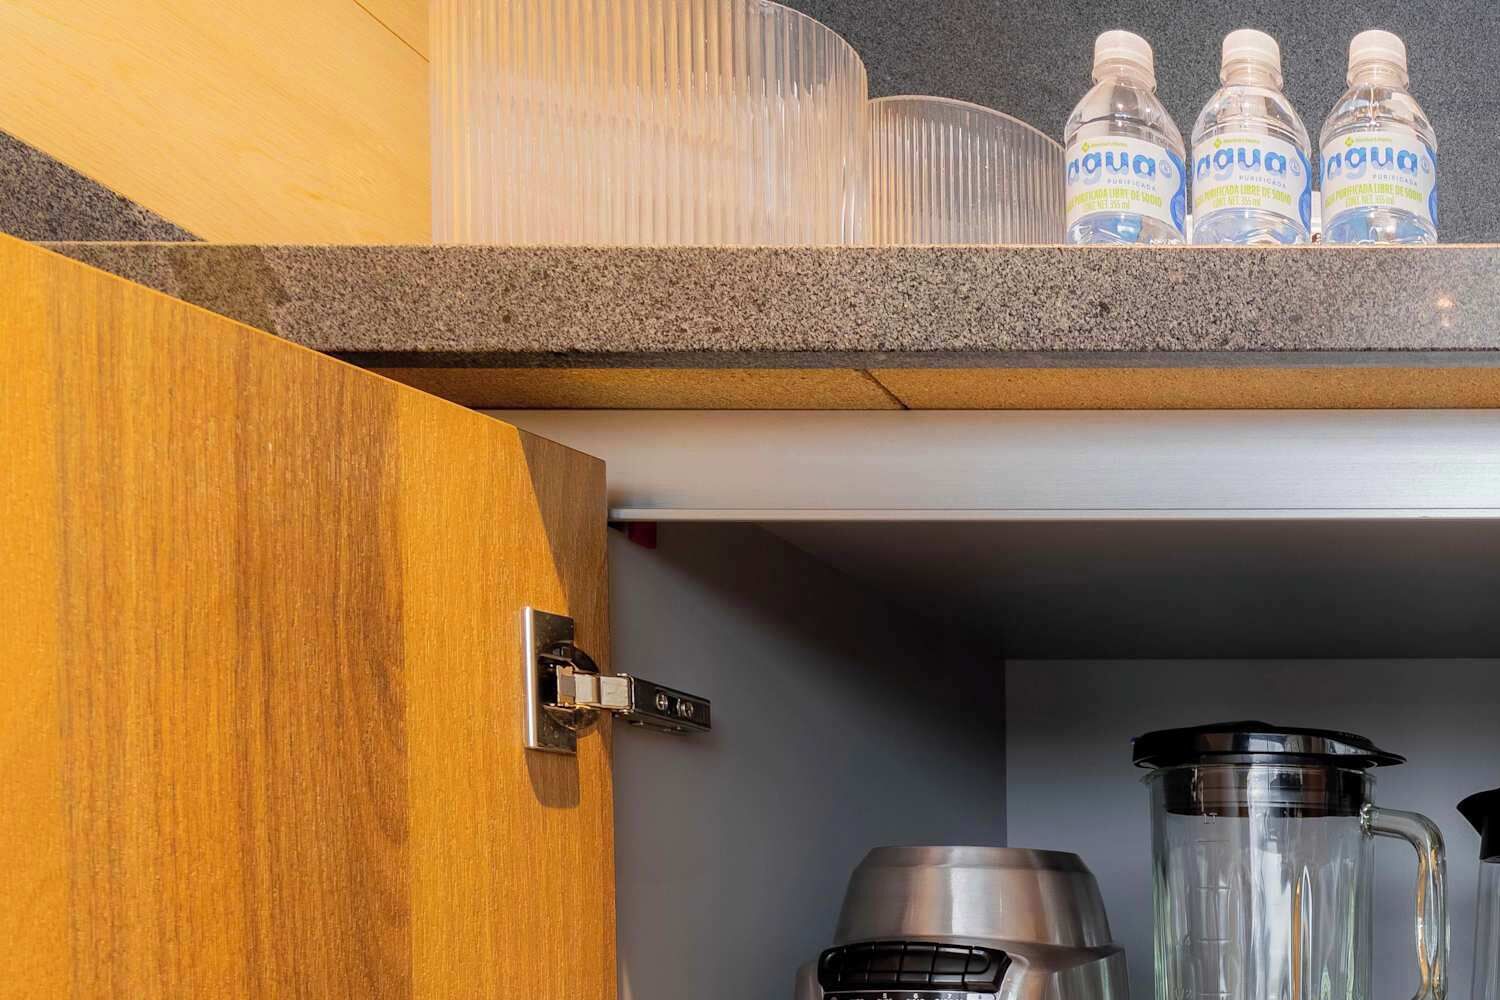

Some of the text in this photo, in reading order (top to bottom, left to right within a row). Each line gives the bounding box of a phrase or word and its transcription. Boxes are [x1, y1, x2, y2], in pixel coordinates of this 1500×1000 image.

[1107, 178, 1157, 192] PURIFICADA
[1239, 175, 1288, 189] PURIFICADA
[1372, 174, 1418, 187] PURIFICADA
